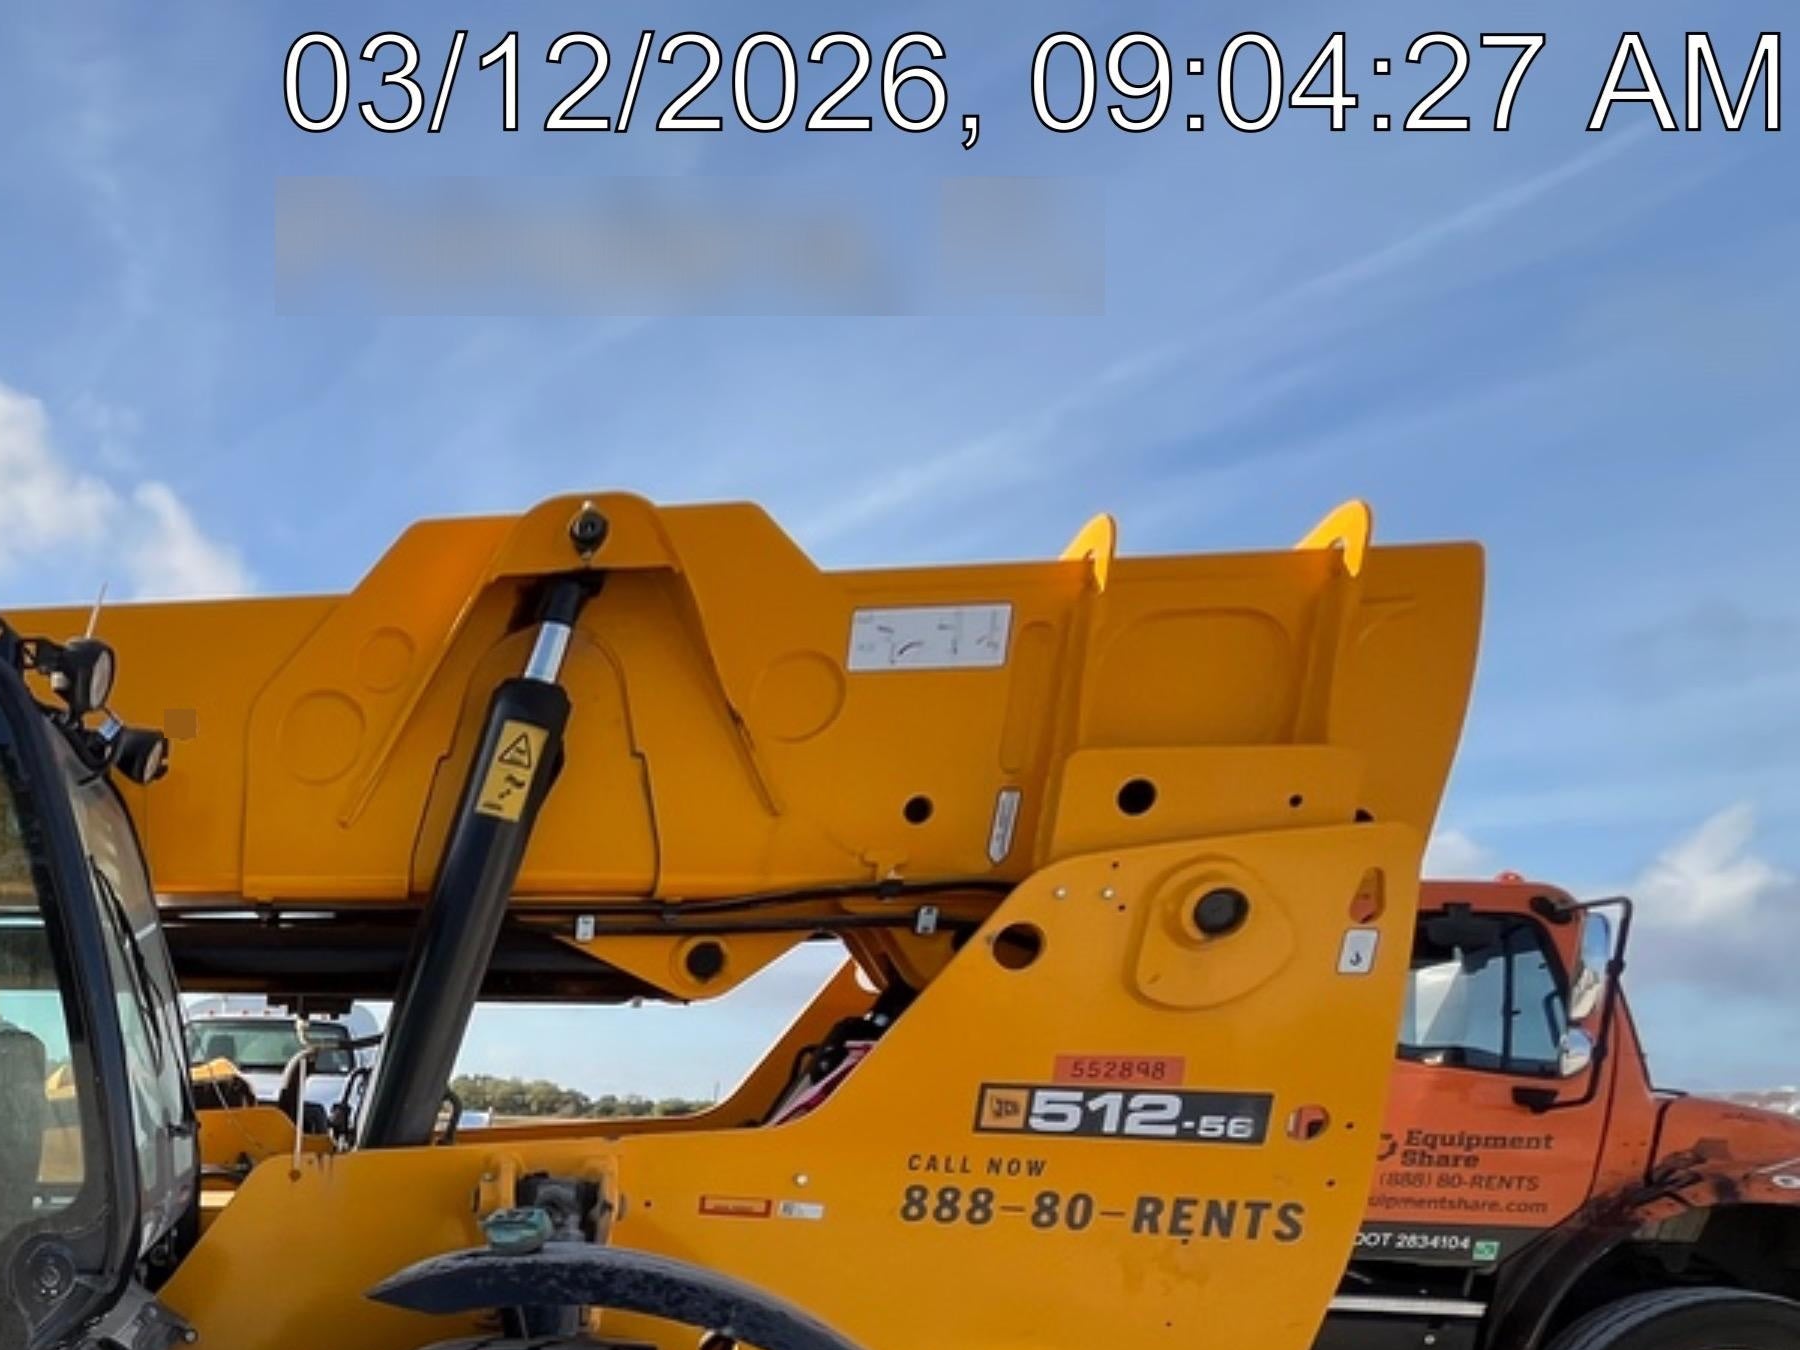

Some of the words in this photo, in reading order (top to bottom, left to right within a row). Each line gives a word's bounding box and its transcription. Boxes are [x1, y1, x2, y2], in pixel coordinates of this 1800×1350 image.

[1069, 1060, 1167, 1080] 552898
[1028, 1090, 1254, 1139] 512-56
[1405, 1129, 1554, 1151] Equipment
[907, 1153, 973, 1175] CALL
[986, 1157, 1046, 1177] NOW
[1400, 1150, 1480, 1168] Share
[1380, 1172, 1432, 1188] (888)
[1436, 1173, 1540, 1192] 80-RENTS
[899, 1183, 1306, 1243] 888-80-RENTS
[1394, 1232, 1471, 1249] 2834104
